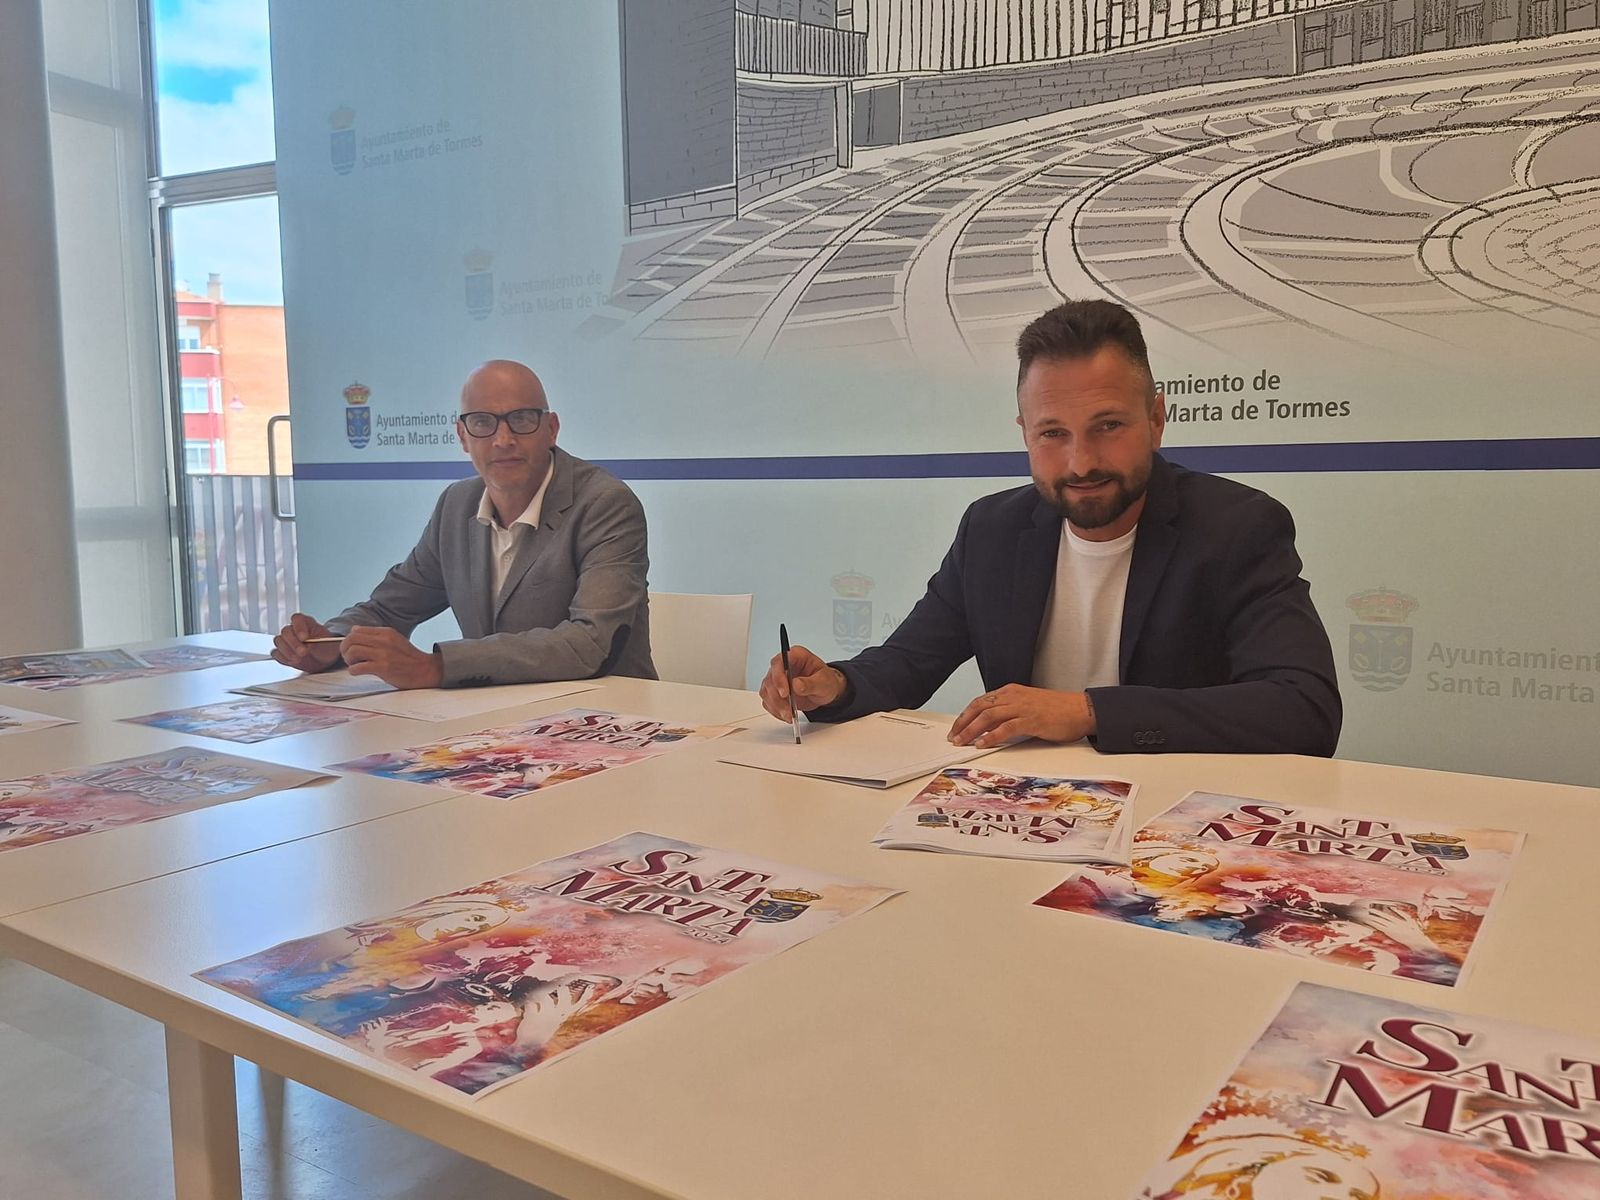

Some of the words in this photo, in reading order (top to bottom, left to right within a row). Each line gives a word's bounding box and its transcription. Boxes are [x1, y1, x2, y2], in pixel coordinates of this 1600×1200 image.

[437, 120, 450, 134] de
[361, 153, 391, 169] Santa
[393, 145, 425, 163] Marta
[428, 140, 441, 156] de
[444, 135, 483, 154] Tormes
[587, 270, 601, 285] de
[501, 299, 534, 316] Santa
[537, 295, 573, 312] Marta
[577, 292, 591, 308] de
[1155, 374, 1244, 395] amiento
[1252, 369, 1281, 391] de
[376, 411, 447, 431] Ayuntamiento
[1231, 399, 1259, 420] de
[1265, 399, 1350, 419] Tormes
[377, 432, 405, 446] Santa
[408, 432, 439, 445] Marta
[442, 431, 455, 444] de
[1427, 641, 1600, 672] Ayuntamient
[1426, 671, 1500, 697] Santa
[1512, 677, 1595, 703] Marta
[1222, 804, 1406, 846] SANTA
[1197, 822, 1446, 870] MARTA
[611, 849, 773, 904] SANTA
[534, 868, 755, 937] MARTA
[1356, 1018, 1600, 1110] SAN
[1308, 1058, 1600, 1160] MAR
